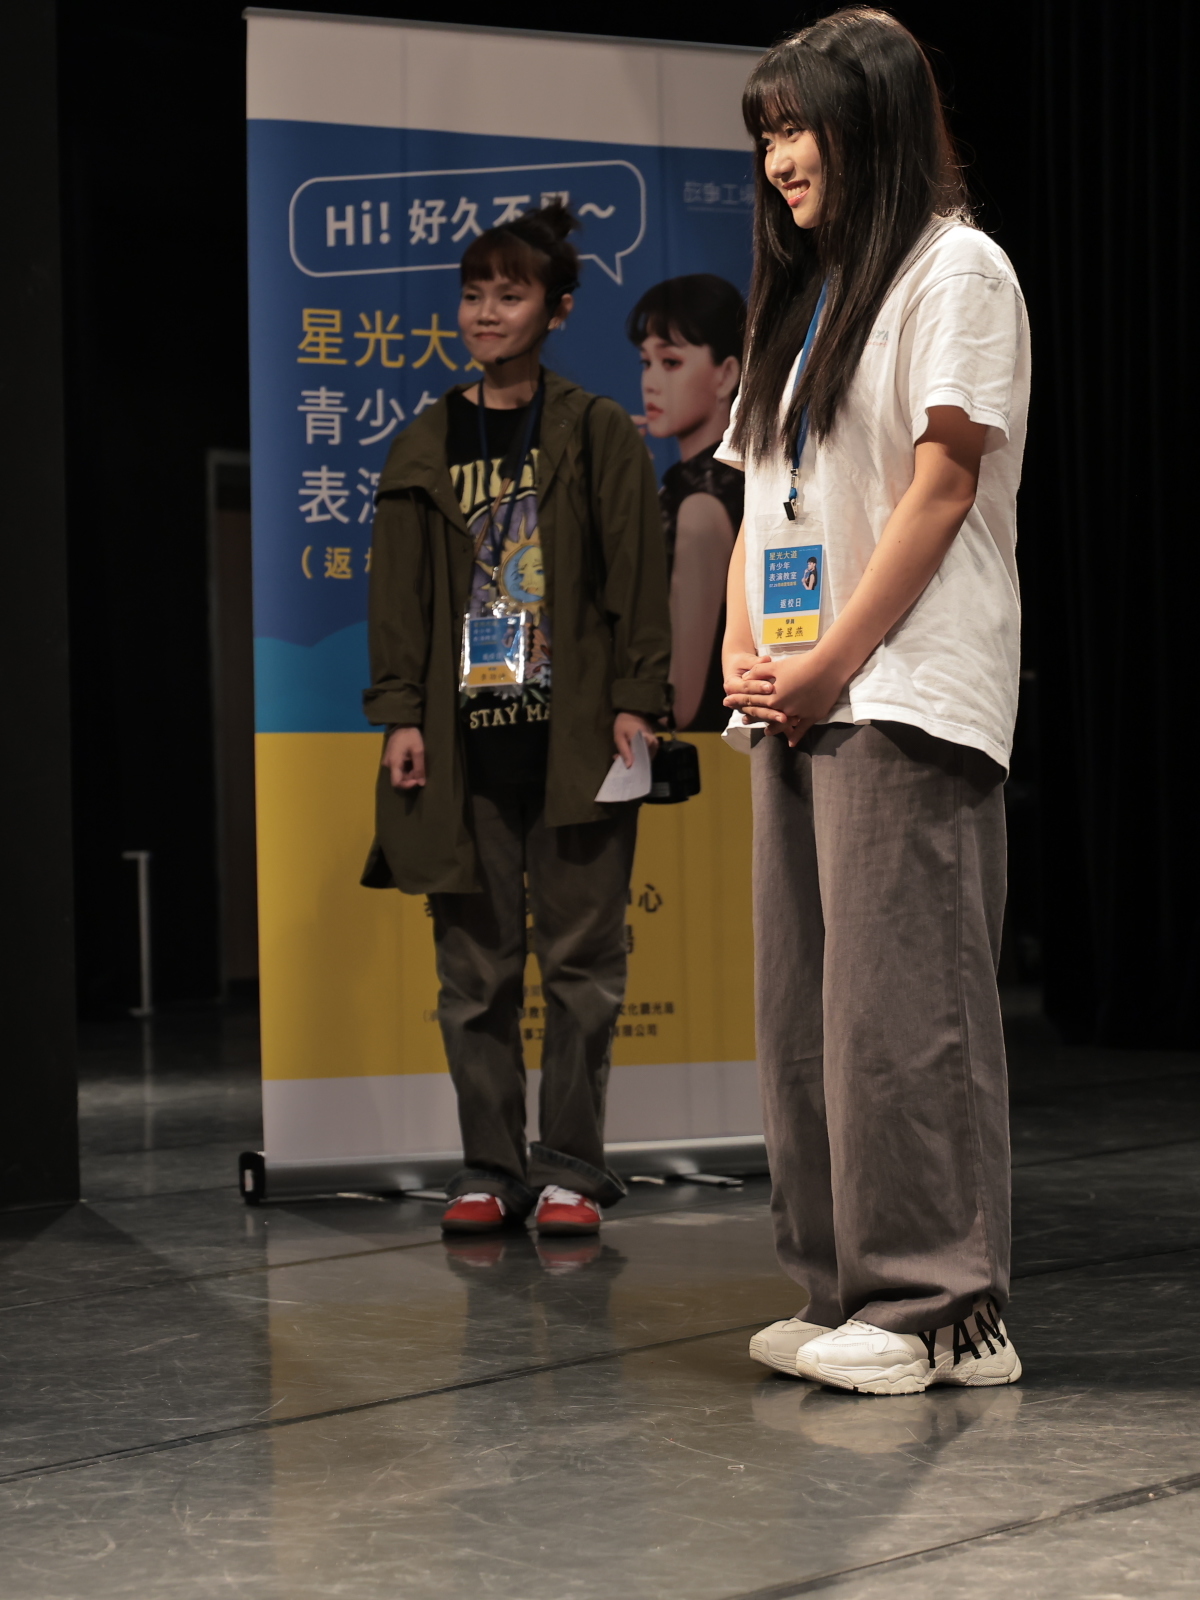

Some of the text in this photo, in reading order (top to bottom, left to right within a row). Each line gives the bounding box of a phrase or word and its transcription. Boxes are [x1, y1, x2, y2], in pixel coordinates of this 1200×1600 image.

[326, 200, 391, 247] Hi!
[297, 308, 485, 372] 星光大
[301, 545, 371, 579] (返
[769, 562, 791, 571] 青少年
[469, 702, 519, 729] STAY
